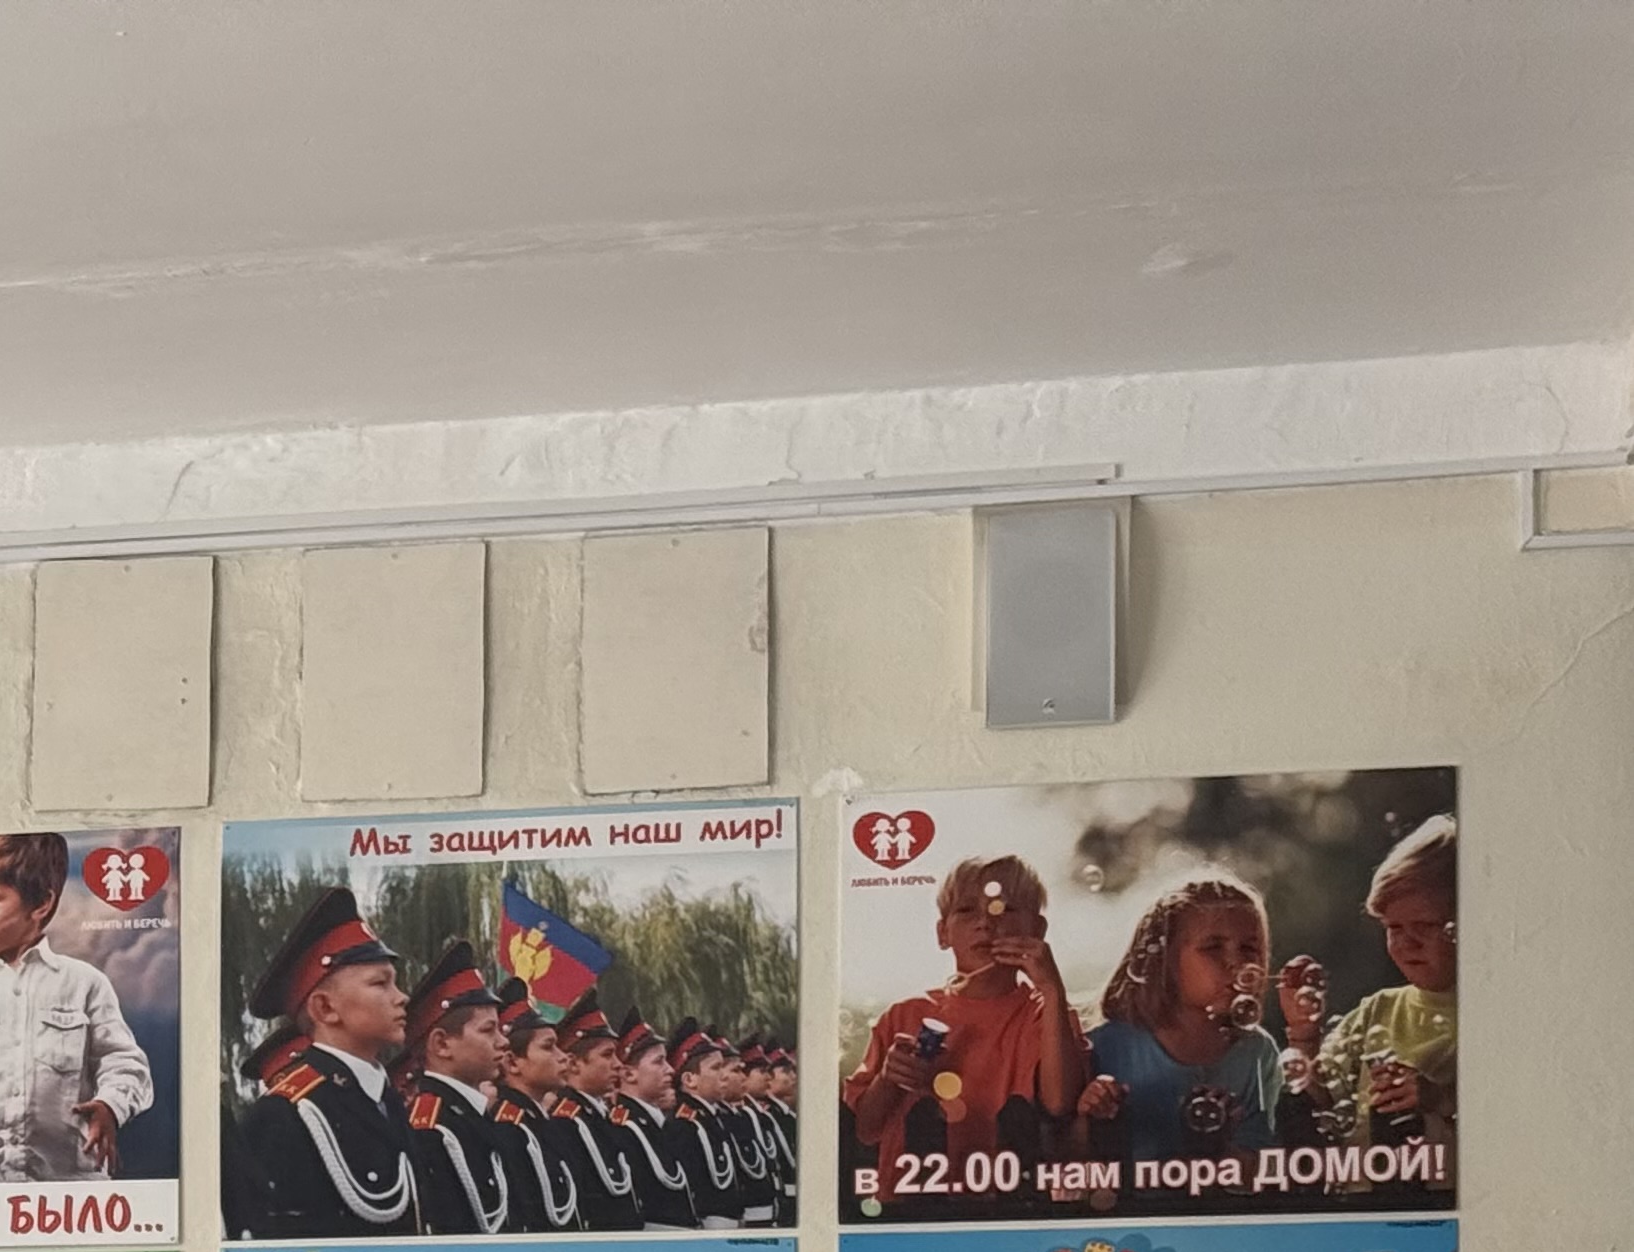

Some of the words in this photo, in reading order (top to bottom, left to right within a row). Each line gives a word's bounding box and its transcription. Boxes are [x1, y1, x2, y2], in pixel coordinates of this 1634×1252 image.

[350, 829, 412, 857] Мы
[429, 824, 592, 855] защитим
[609, 821, 682, 846] наш
[699, 809, 784, 852] мир!
[854, 1169, 879, 1194] в
[894, 1151, 1021, 1194] 22.00
[1037, 1160, 1120, 1191] нам
[1134, 1157, 1242, 1194] пора
[1253, 1137, 1447, 1188] ДОМОЙ!
[8, 1193, 164, 1233] БЫЛО...
